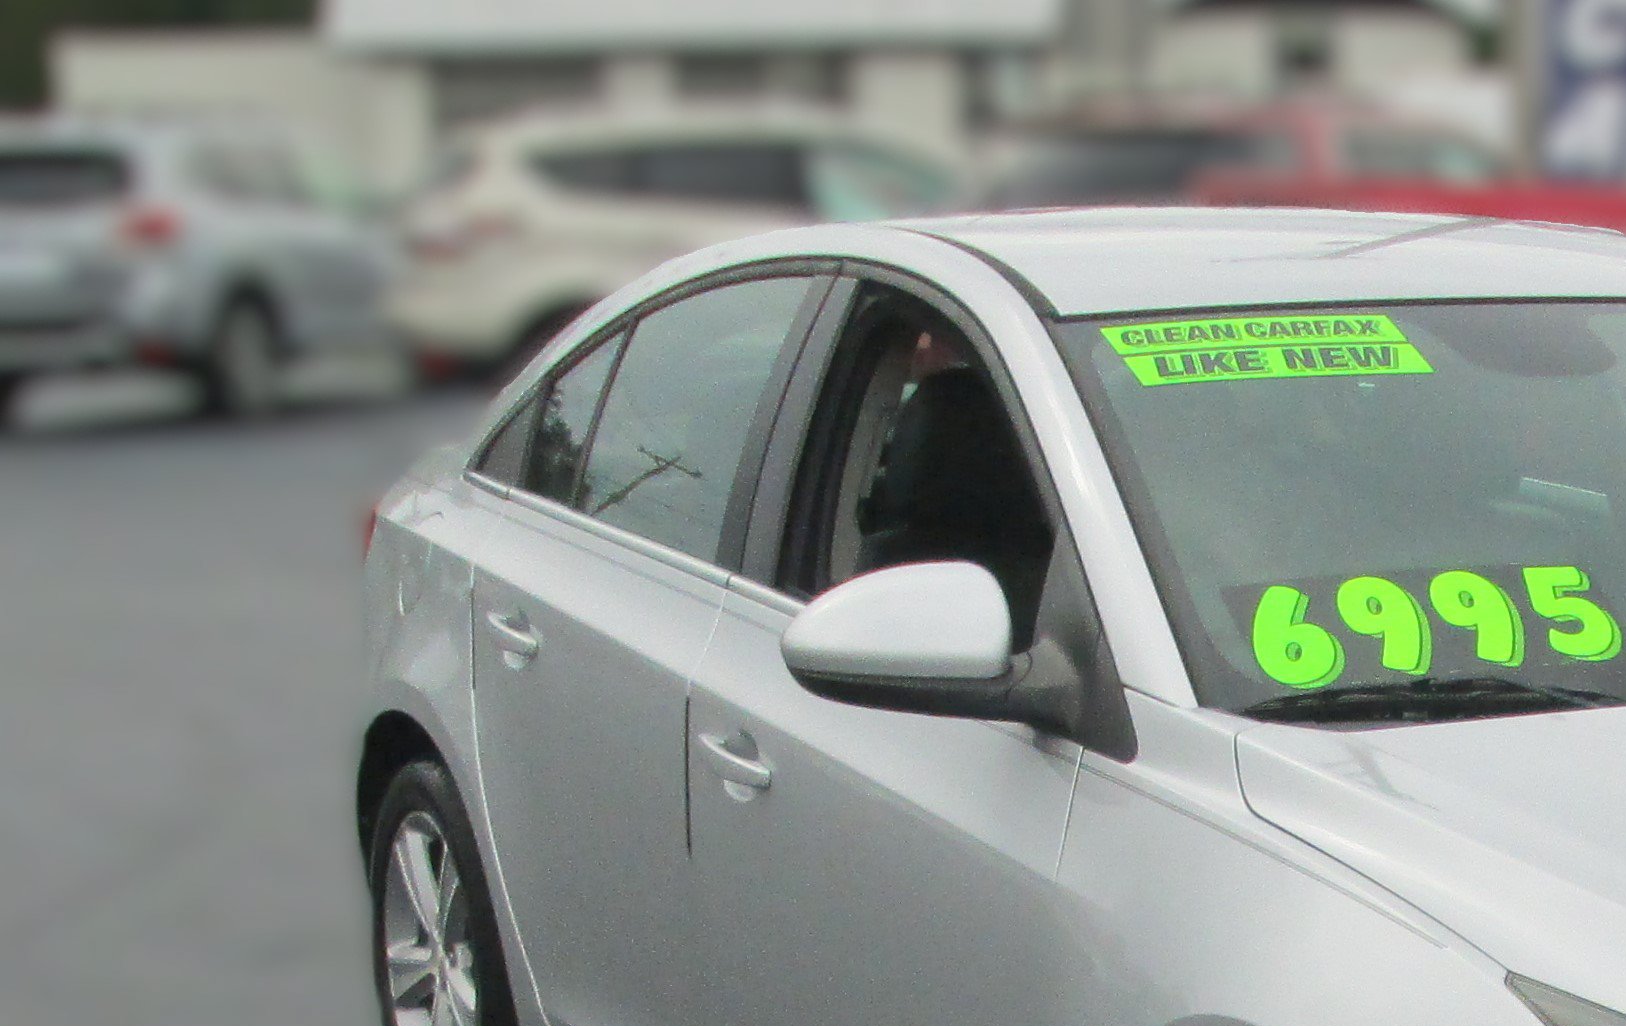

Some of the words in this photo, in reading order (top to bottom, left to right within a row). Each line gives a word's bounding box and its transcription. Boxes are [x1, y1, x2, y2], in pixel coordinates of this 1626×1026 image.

[1120, 322, 1242, 347] CLEAN
[1244, 318, 1381, 341] CARFAX
[1153, 349, 1271, 379] LIKE
[1280, 345, 1398, 371] NEW
[1252, 565, 1623, 688] 6995
